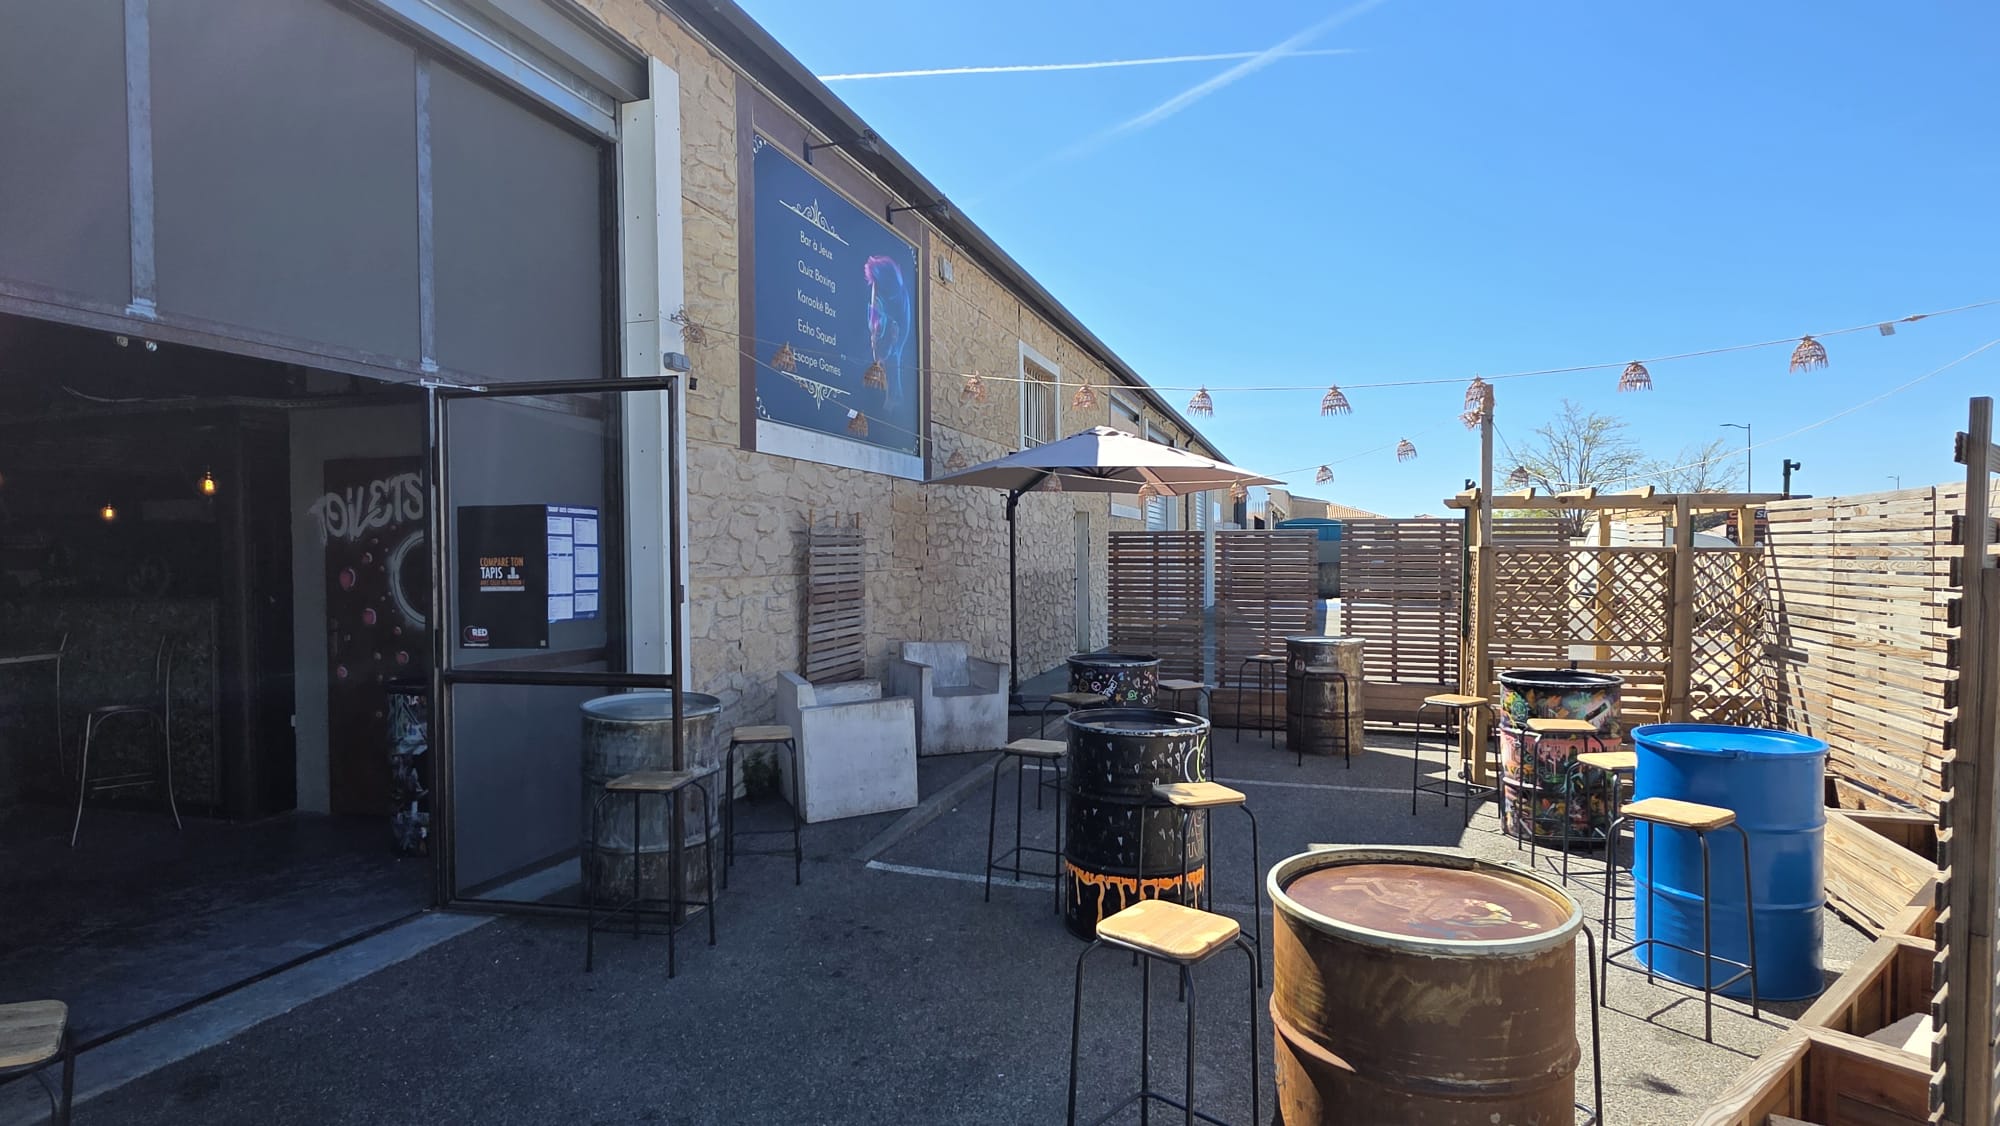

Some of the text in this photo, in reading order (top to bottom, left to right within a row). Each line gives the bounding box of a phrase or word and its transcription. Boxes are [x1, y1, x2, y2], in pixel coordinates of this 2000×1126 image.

[800, 230, 833, 260] Bar à Jeux
[798, 260, 836, 293] Quiz Boxing
[824, 302, 837, 318] Box
[797, 318, 837, 346] Echo Squad
[793, 348, 842, 377] Escape Games
[480, 556, 524, 567] COMPARE TON
[480, 566, 503, 579] TAPIS
[471, 628, 488, 637] RED
